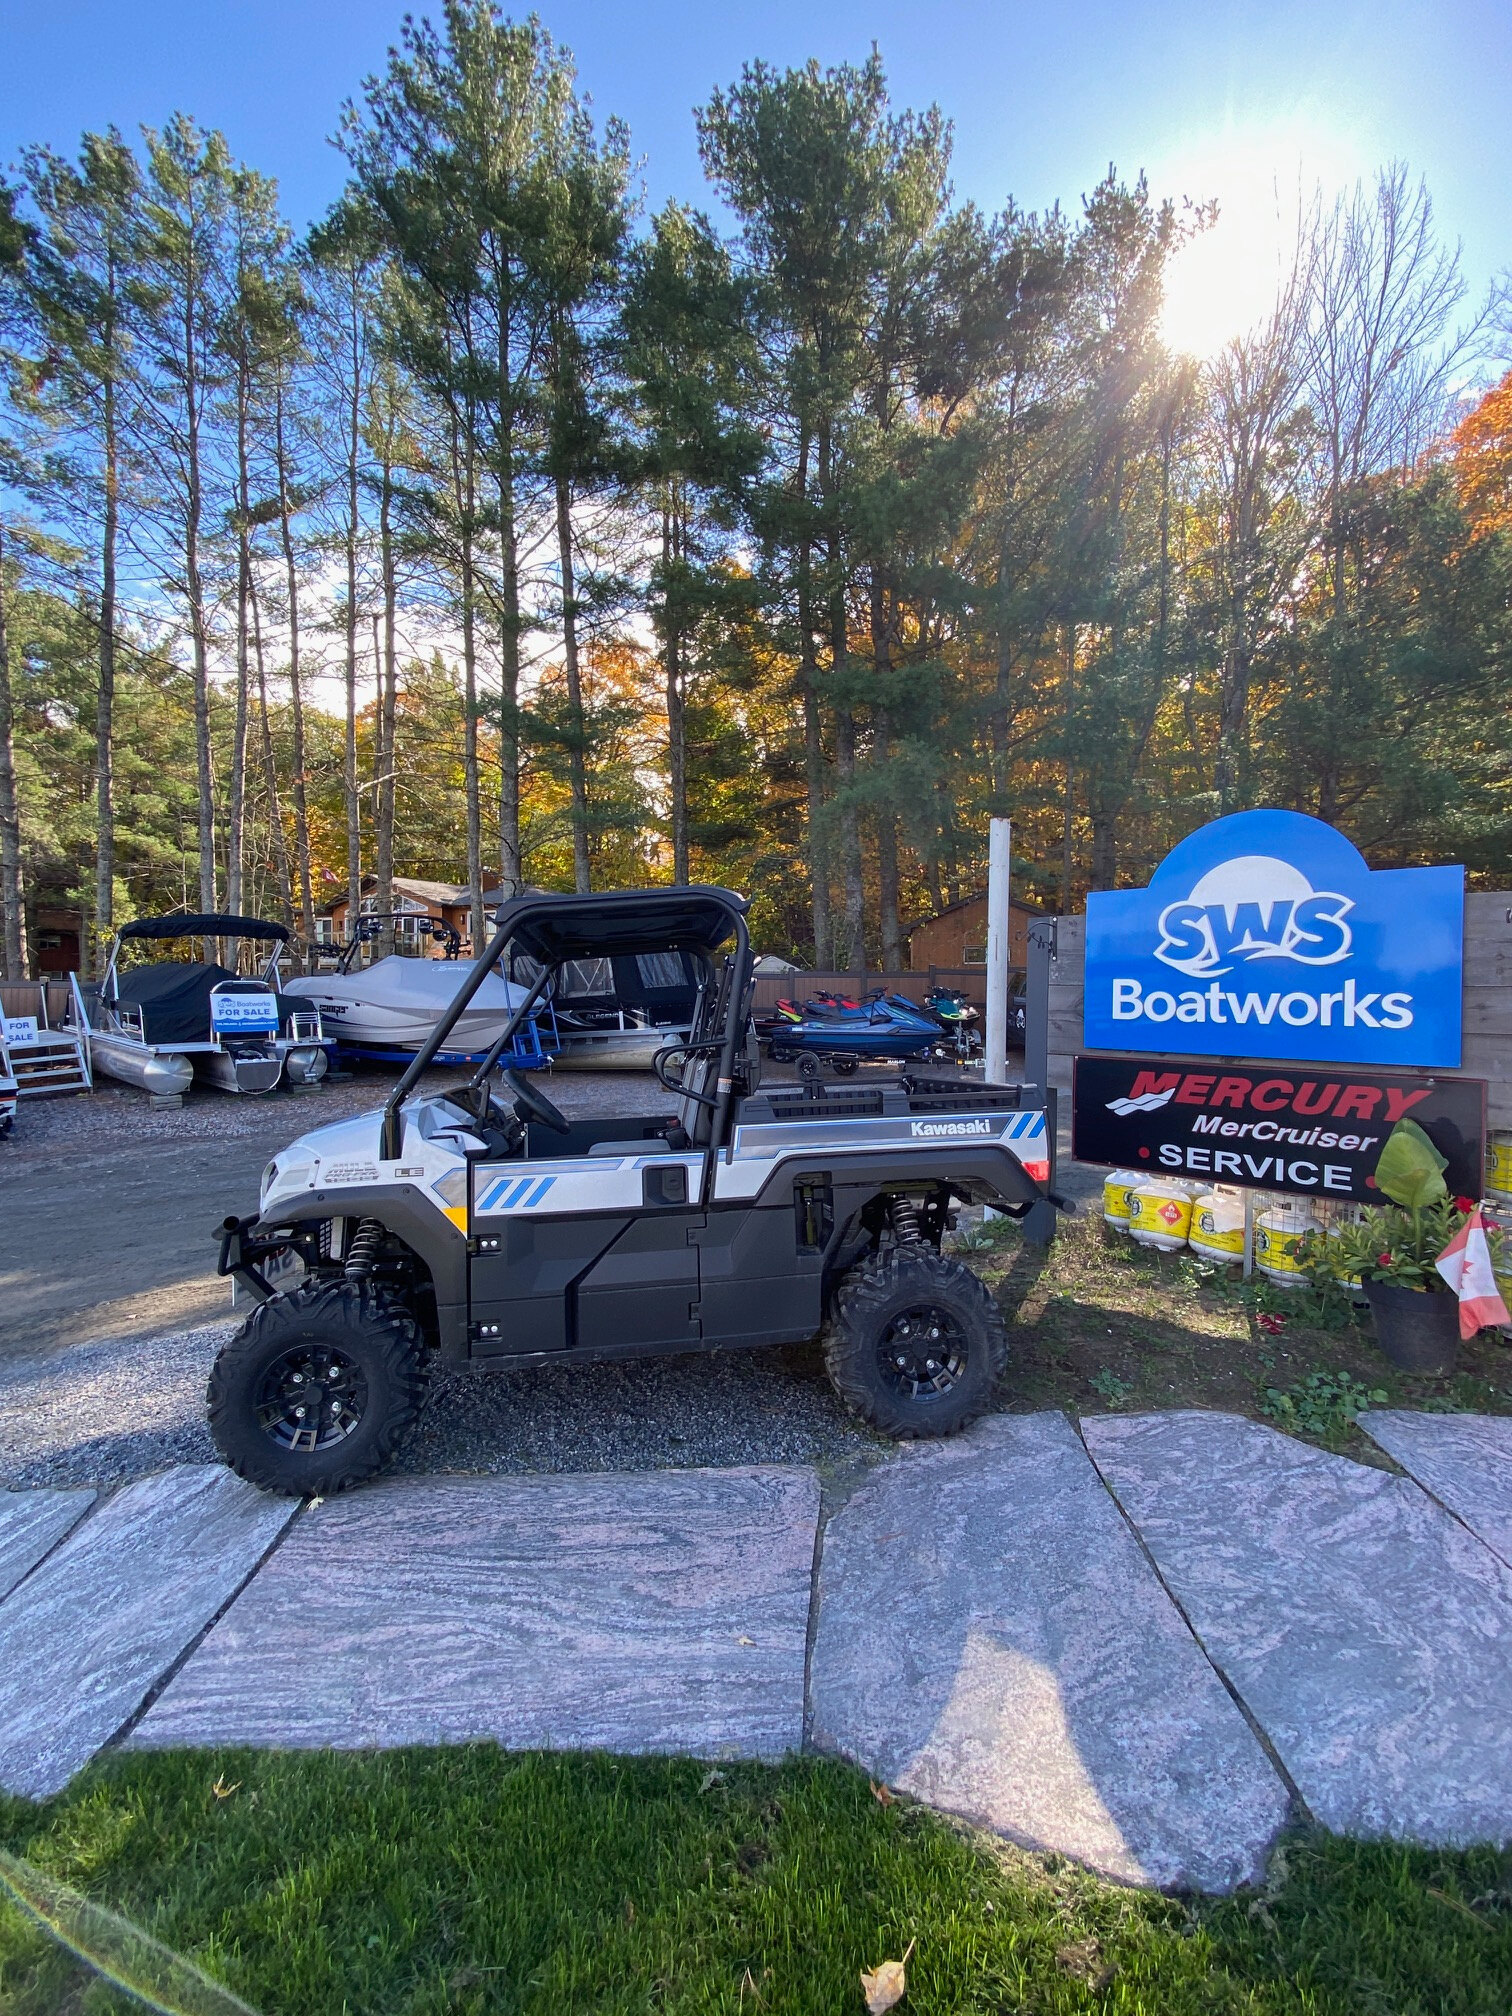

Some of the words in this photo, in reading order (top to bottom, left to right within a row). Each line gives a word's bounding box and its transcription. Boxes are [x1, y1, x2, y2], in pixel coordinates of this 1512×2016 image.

[1153, 892, 1356, 977] SWS
[1111, 978, 1414, 1029] Boatworks
[8, 1033, 34, 1042] SALE
[9, 1021, 30, 1030] FOR
[1127, 1070, 1434, 1122] MERCURY
[911, 1118, 991, 1137] Kawasaki
[1191, 1114, 1379, 1152] MerCruiser
[395, 1167, 424, 1178] LE
[1158, 1143, 1354, 1191] SERVICE
